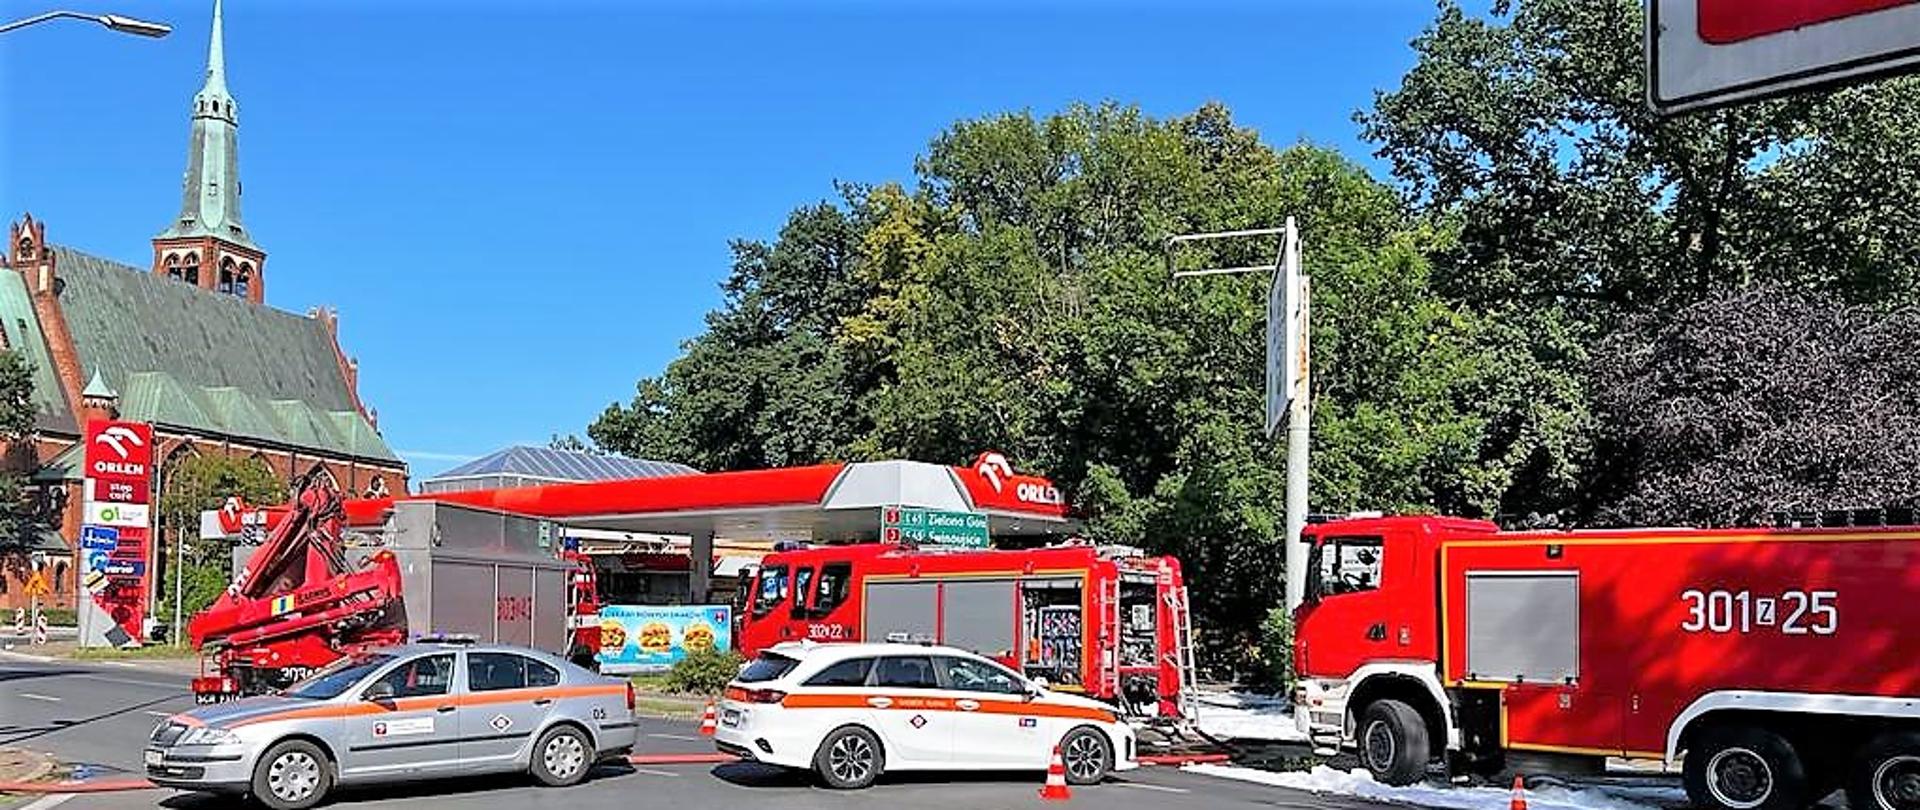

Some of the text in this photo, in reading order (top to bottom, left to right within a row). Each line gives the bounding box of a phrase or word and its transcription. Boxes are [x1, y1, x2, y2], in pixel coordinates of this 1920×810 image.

[94, 461, 144, 475] ORLEN
[928, 513, 964, 527] Zielona
[593, 708, 606, 720] 05
